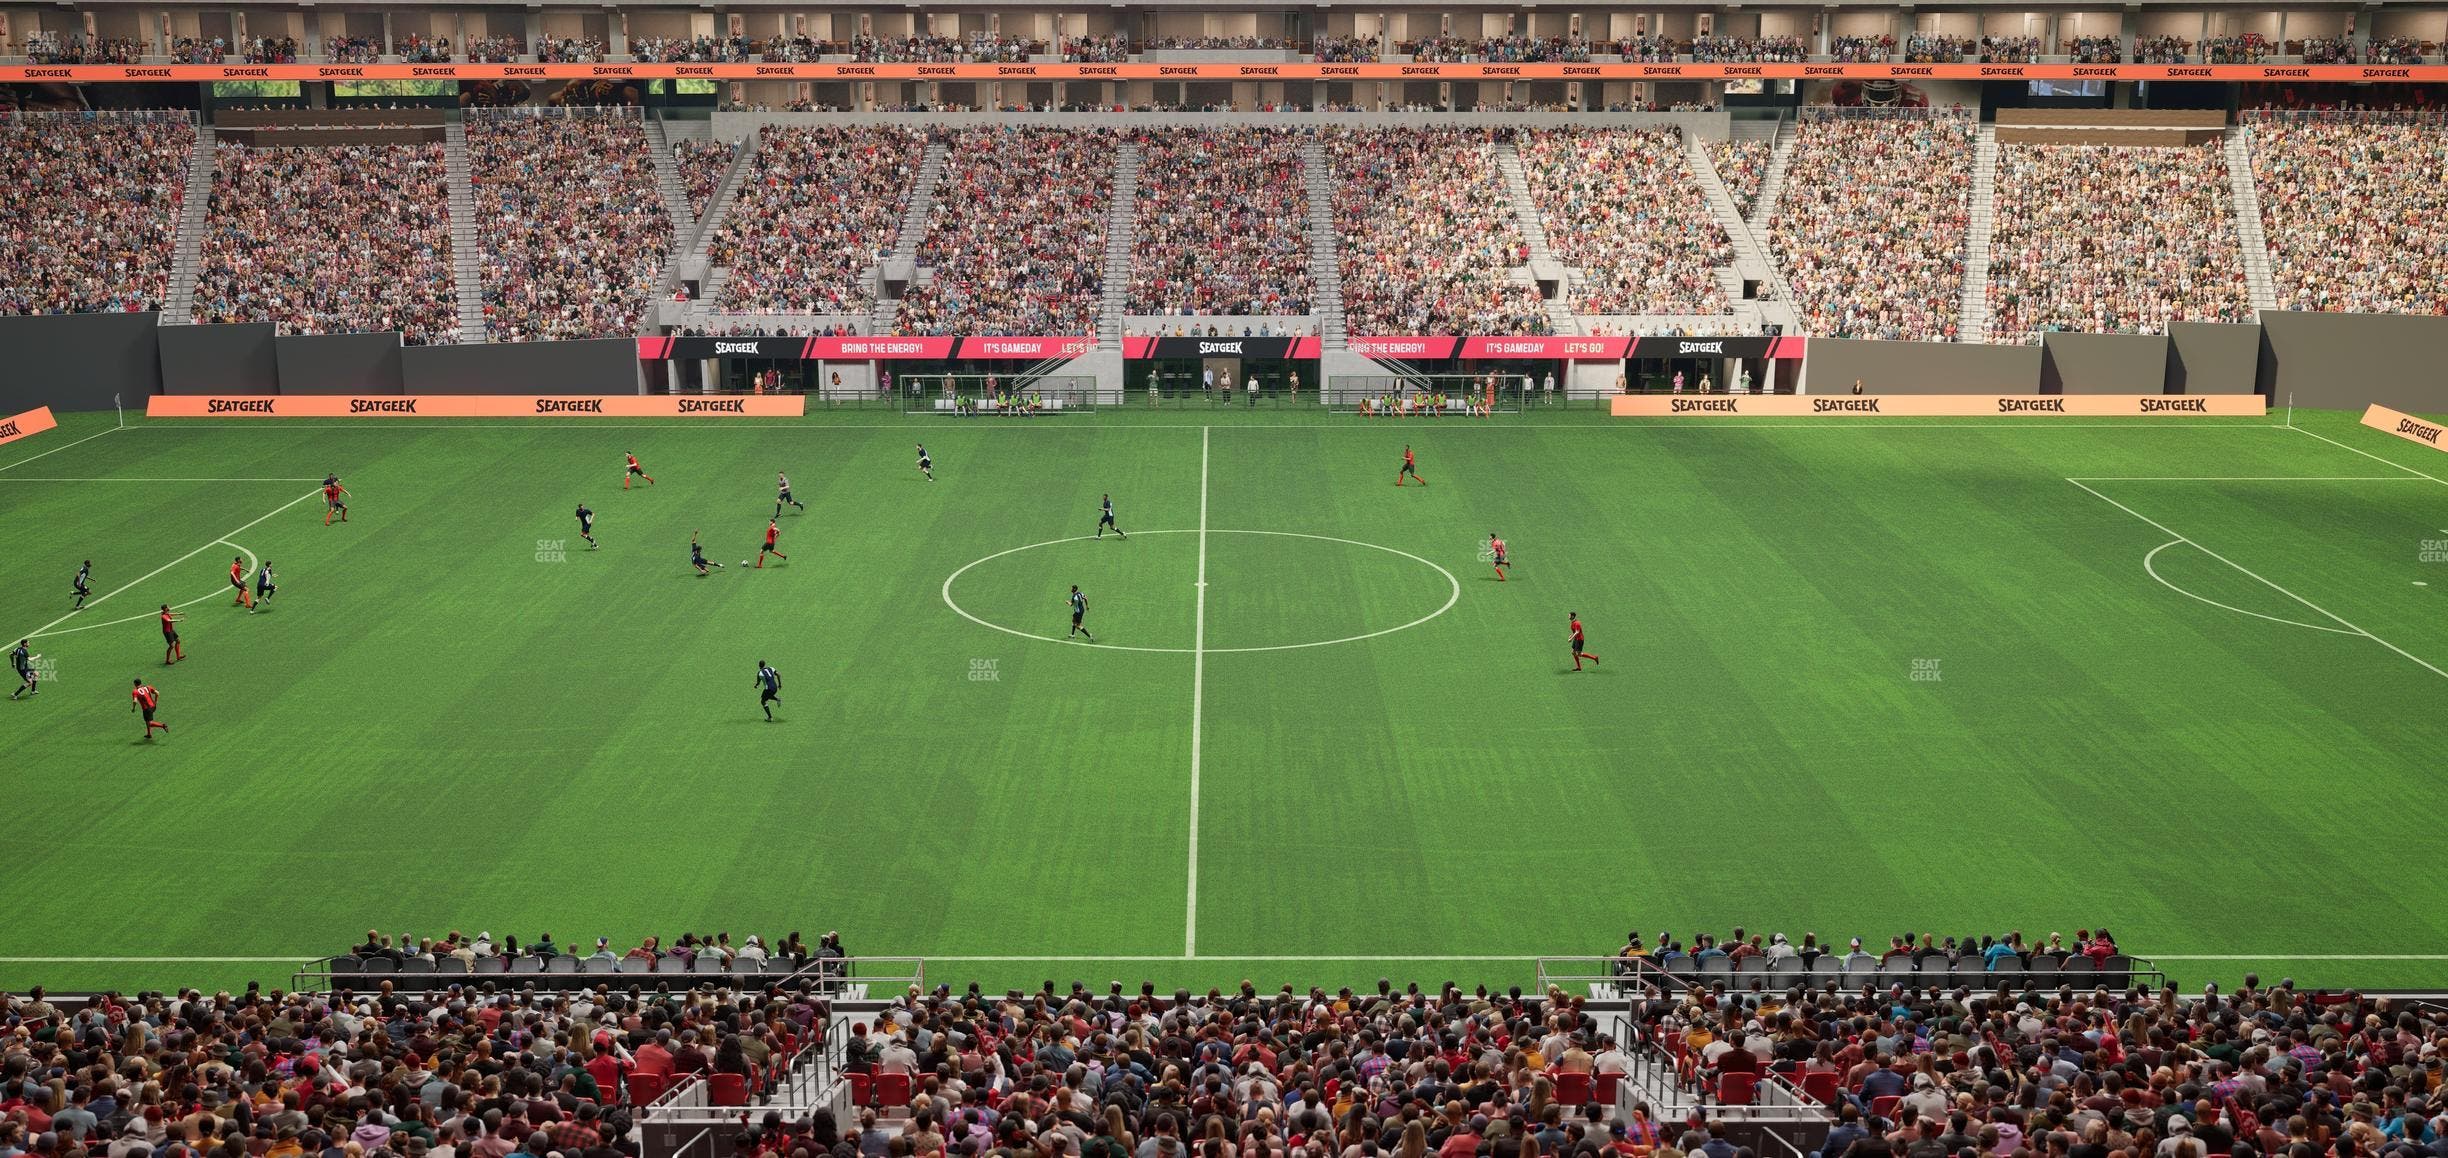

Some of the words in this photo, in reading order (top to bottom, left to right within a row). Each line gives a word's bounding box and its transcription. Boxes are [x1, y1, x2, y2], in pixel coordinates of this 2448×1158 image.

[24, 68, 73, 78] SEATGEEK
[124, 68, 172, 78] SEATGEEK
[223, 67, 269, 77] SEATGEEK
[319, 67, 364, 77] SEATGEEK
[412, 67, 456, 76] SEATGEEK
[503, 67, 546, 76] SEATGEEK
[593, 66, 633, 75] SEATGEEK
[675, 66, 714, 75] SEATGEEK
[756, 66, 795, 75] SEATGEEK
[837, 66, 875, 75] SEATGEEK
[917, 66, 956, 75] SEATGEEK
[998, 66, 1037, 75] SEATGEEK
[1079, 66, 1117, 75] SEATGEEK
[1159, 66, 1198, 75] SEATGEEK
[1240, 66, 1279, 75] SEATGEEK
[1321, 66, 1359, 75] SEATGEEK
[1401, 66, 1440, 75] SEATGEEK
[1482, 66, 1521, 75] SEATGEEK
[1562, 66, 1601, 75] SEATGEEK
[1643, 66, 1681, 75] SEATGEEK
[1724, 66, 1762, 75] SEATGEEK
[1804, 66, 1844, 75] SEATGEEK
[1890, 66, 1933, 76] SEATGEEK
[1980, 67, 2024, 76] SEATGEEK
[2072, 67, 2117, 77] SEATGEEK
[2167, 67, 2212, 77] SEATGEEK
[2263, 68, 2310, 78] SEATGEEK
[2362, 68, 2410, 78] SEATGEEK
[715, 342, 759, 354] SEATGEEK
[841, 343, 868, 353] BRING
[870, 343, 886, 353] THE
[887, 343, 923, 353] ENERGY!
[983, 343, 1000, 353] IT'S
[1001, 343, 1042, 353] GAMEDAY
[1199, 342, 1243, 354] SEATGEEK
[1372, 343, 1388, 353] THE
[1389, 343, 1425, 353] ENERGY!
[1486, 343, 1503, 353] IT'S
[1504, 343, 1545, 353] GAMEDAY
[1564, 343, 1588, 353] LET'S
[1589, 343, 1605, 353] GO!
[1679, 341, 1723, 354] SEATGEEK
[207, 398, 275, 414] SEATGEEK
[349, 398, 417, 414] SEATGEEK
[535, 398, 603, 414] SEATGEEK
[677, 398, 745, 414] SEATGEEK
[1671, 398, 1739, 414] SEATGEEK
[1813, 398, 1881, 414] SEATGEEK
[1998, 398, 2066, 414] SEATGEEK
[2139, 398, 2208, 414] SEATGEEK
[2396, 418, 2442, 444] SEATGEEK
